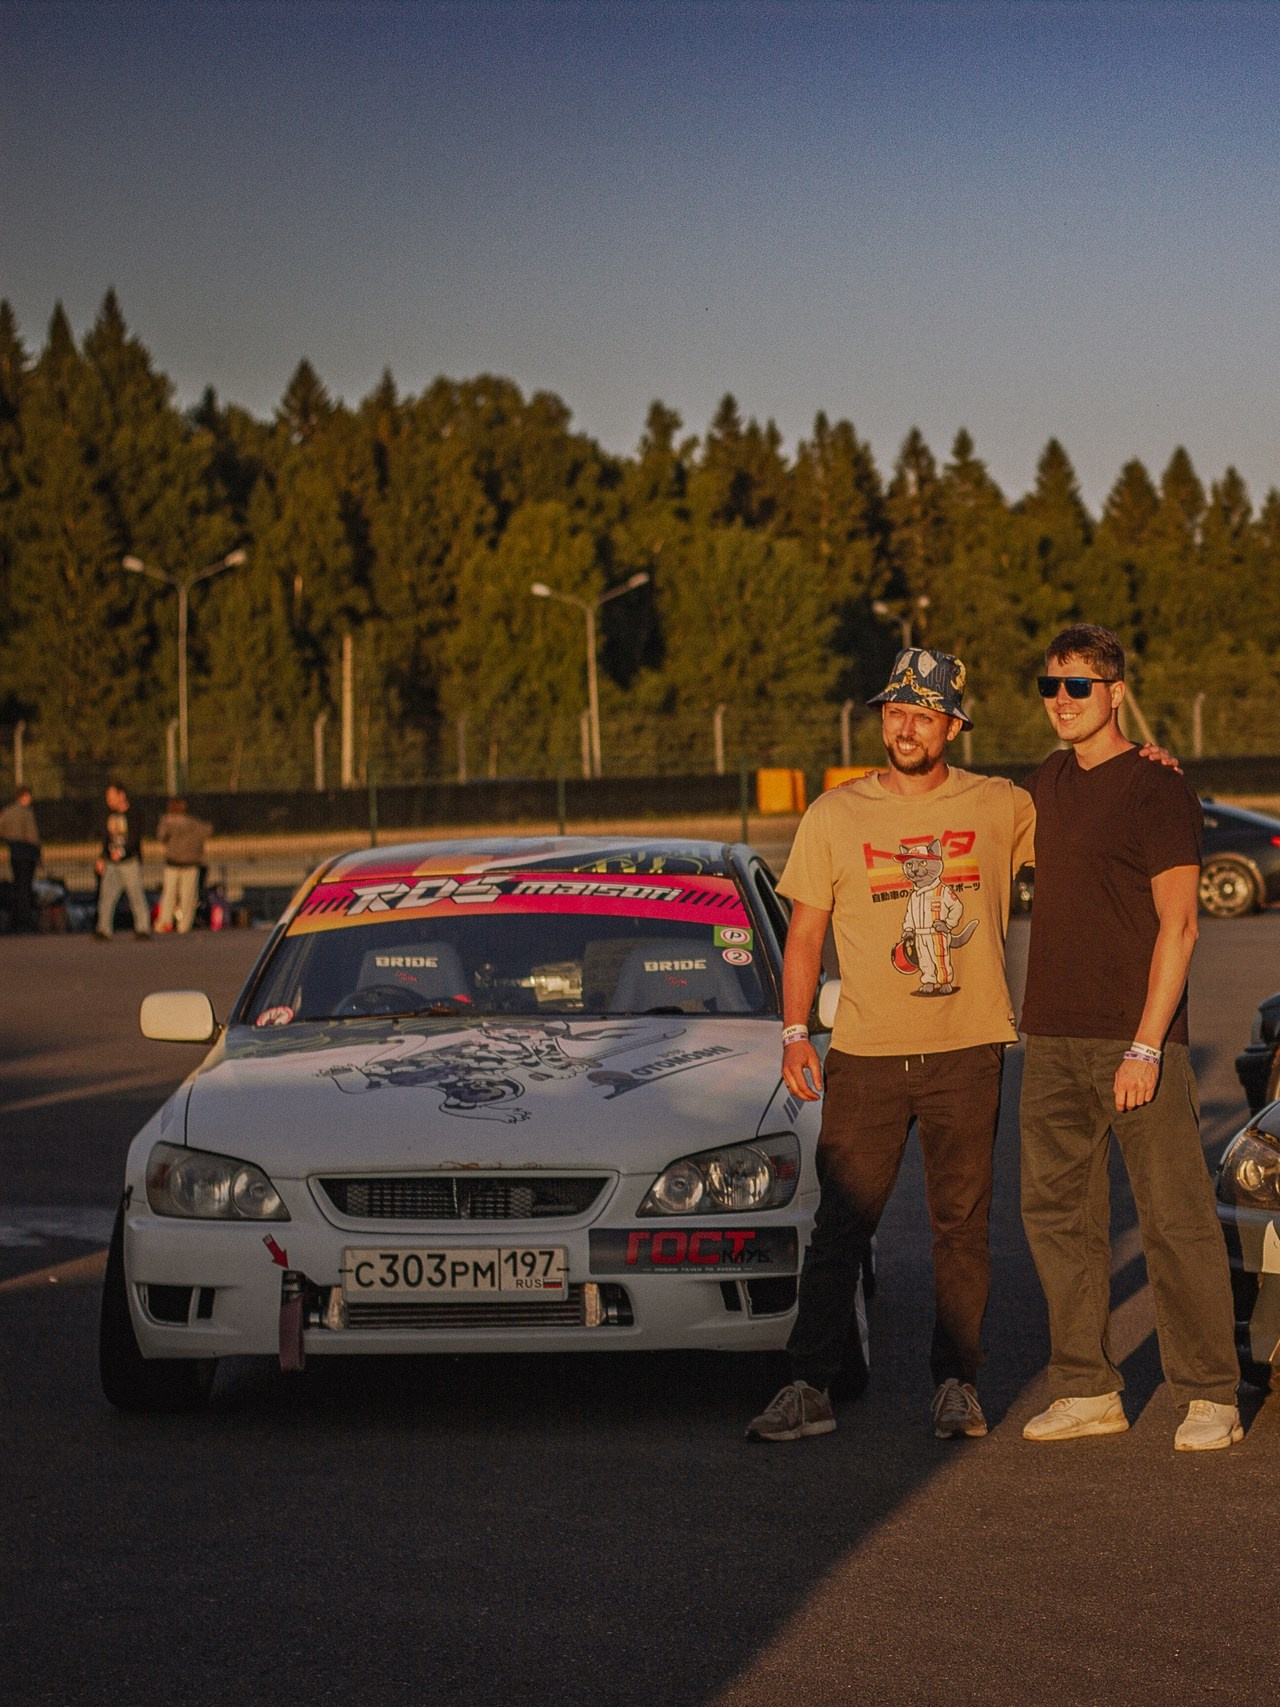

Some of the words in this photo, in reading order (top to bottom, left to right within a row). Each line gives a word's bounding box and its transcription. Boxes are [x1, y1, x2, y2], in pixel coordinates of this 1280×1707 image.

[863, 830, 976, 869] トタ
[345, 876, 516, 916] RDS
[375, 956, 438, 968] BRIDE
[644, 959, 707, 972] BRIDE
[733, 952, 743, 961] 2
[624, 1231, 756, 1265] ГОСТ
[503, 1250, 555, 1277] 197
[516, 1279, 542, 1289] RUS
